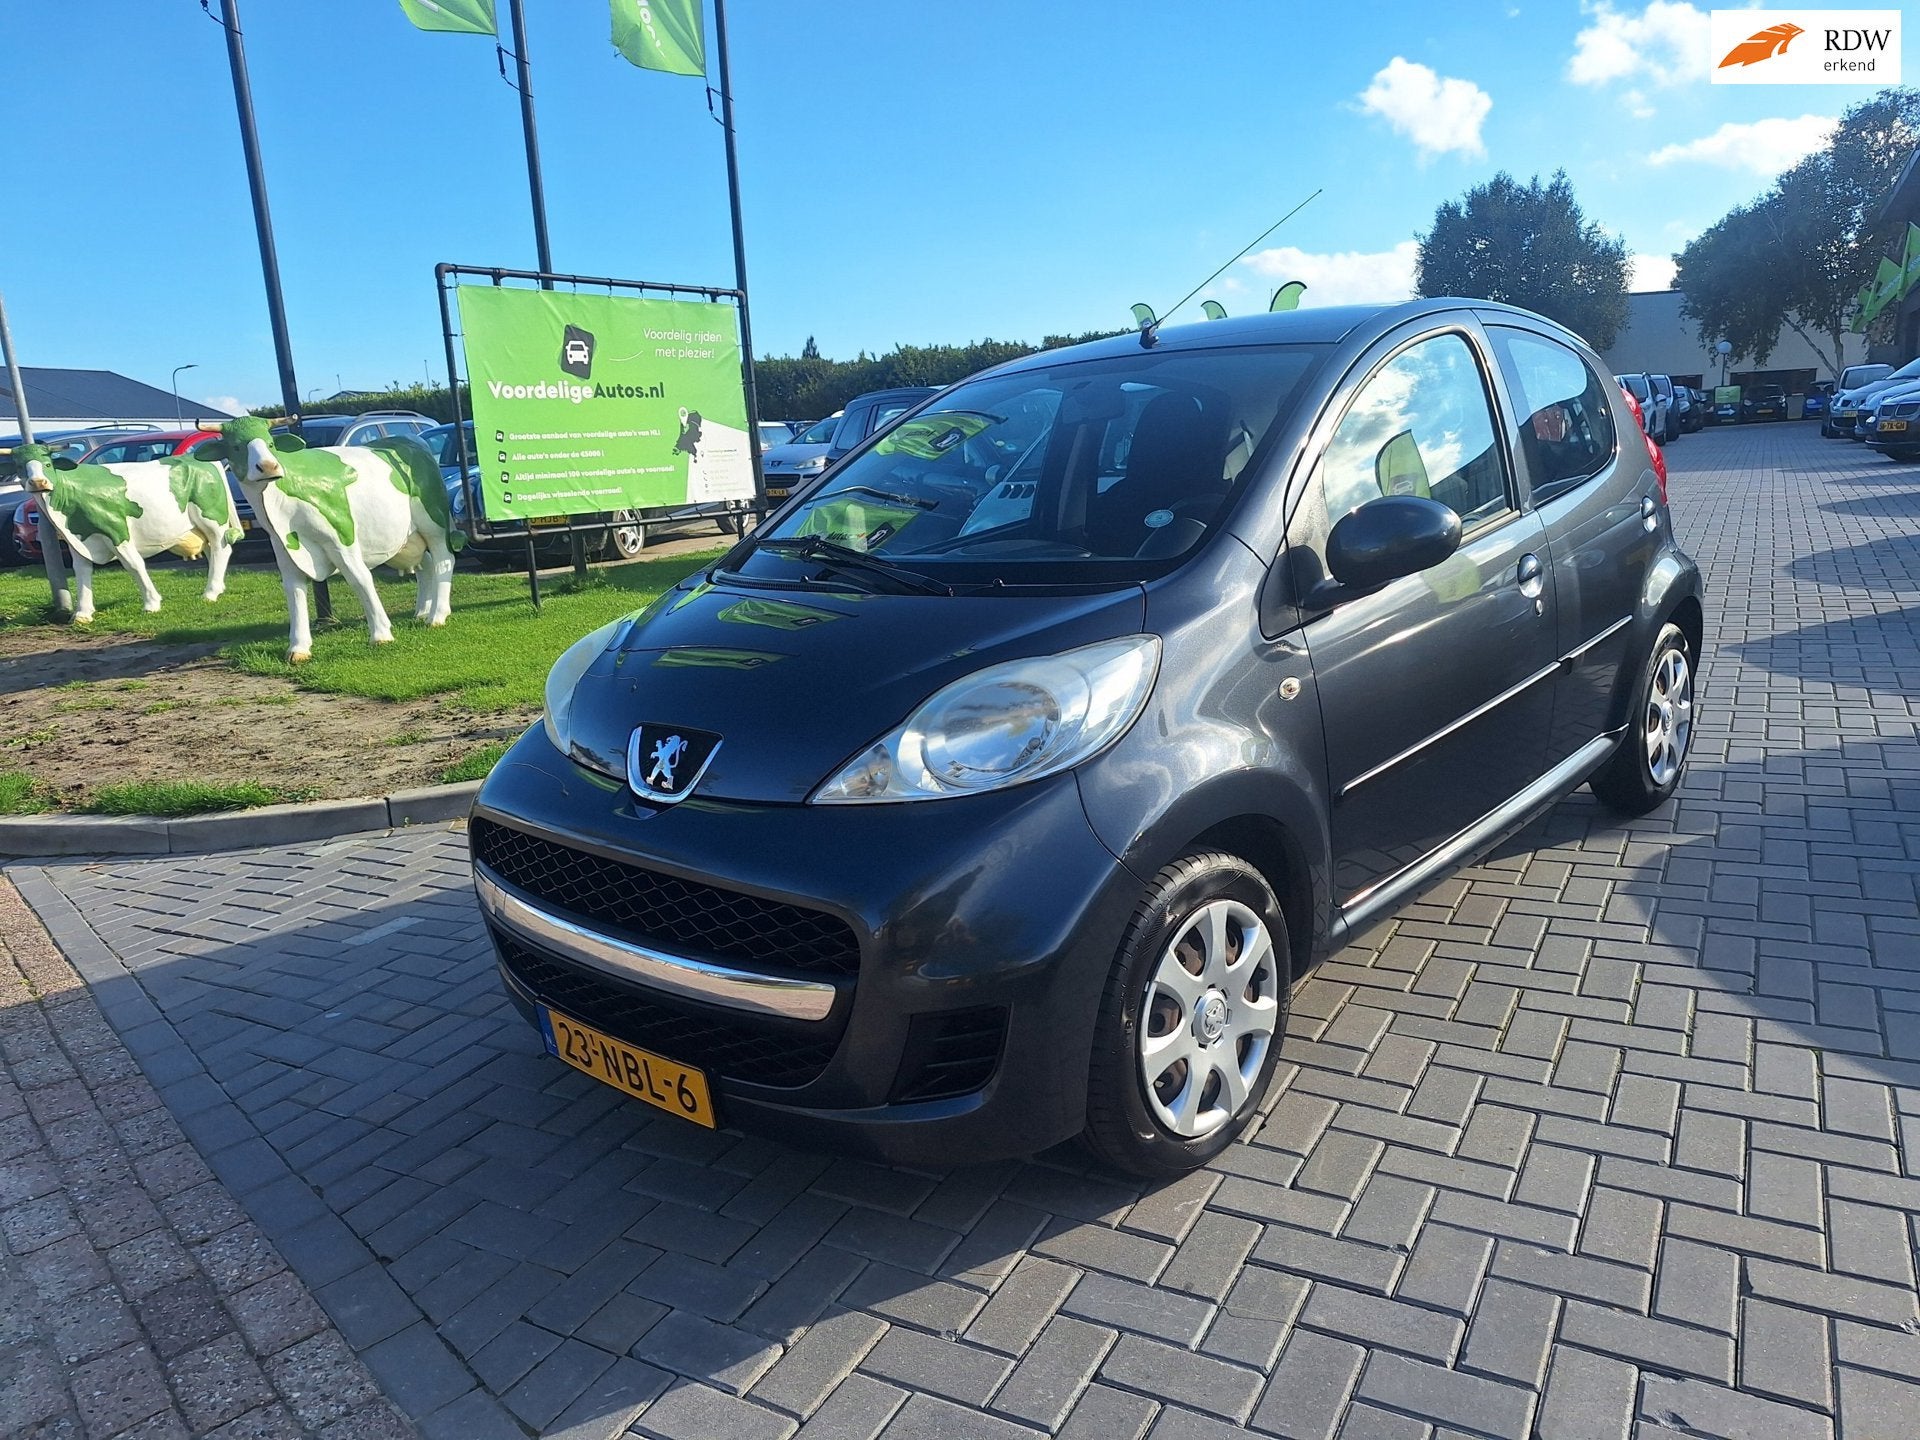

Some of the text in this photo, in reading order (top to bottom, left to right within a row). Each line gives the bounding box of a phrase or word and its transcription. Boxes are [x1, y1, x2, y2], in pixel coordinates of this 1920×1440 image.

[643, 327, 722, 347] Voordelig rijden
[655, 347, 715, 360] met plezier!
[487, 380, 665, 405] VoordeligeAutos.nl
[512, 453, 526, 461] Alle
[515, 472, 534, 481] Altijd
[558, 1021, 698, 1114] 23-NBL-6
